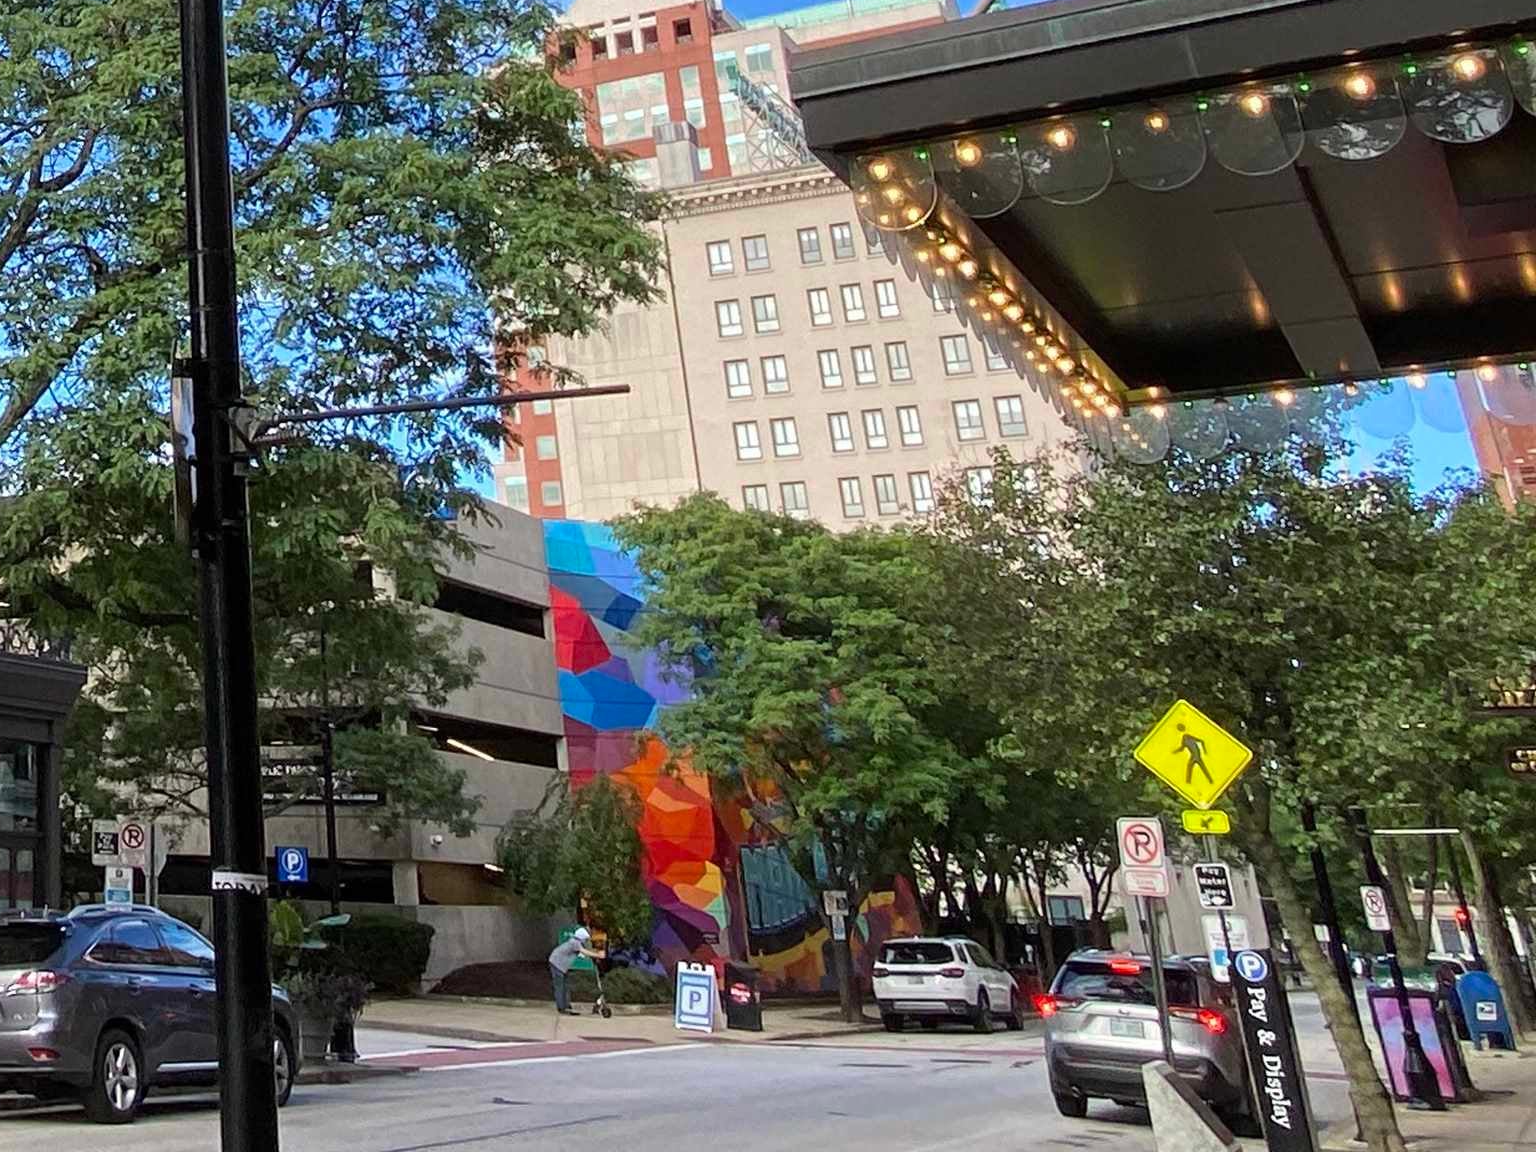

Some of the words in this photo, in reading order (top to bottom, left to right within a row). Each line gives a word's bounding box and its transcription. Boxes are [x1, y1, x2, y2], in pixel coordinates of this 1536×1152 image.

[1241, 953, 1262, 979] P
[688, 990, 702, 1011] P
[1246, 986, 1268, 1023] Pay
[1256, 1028, 1277, 1048] &
[1262, 1054, 1292, 1130] Display
